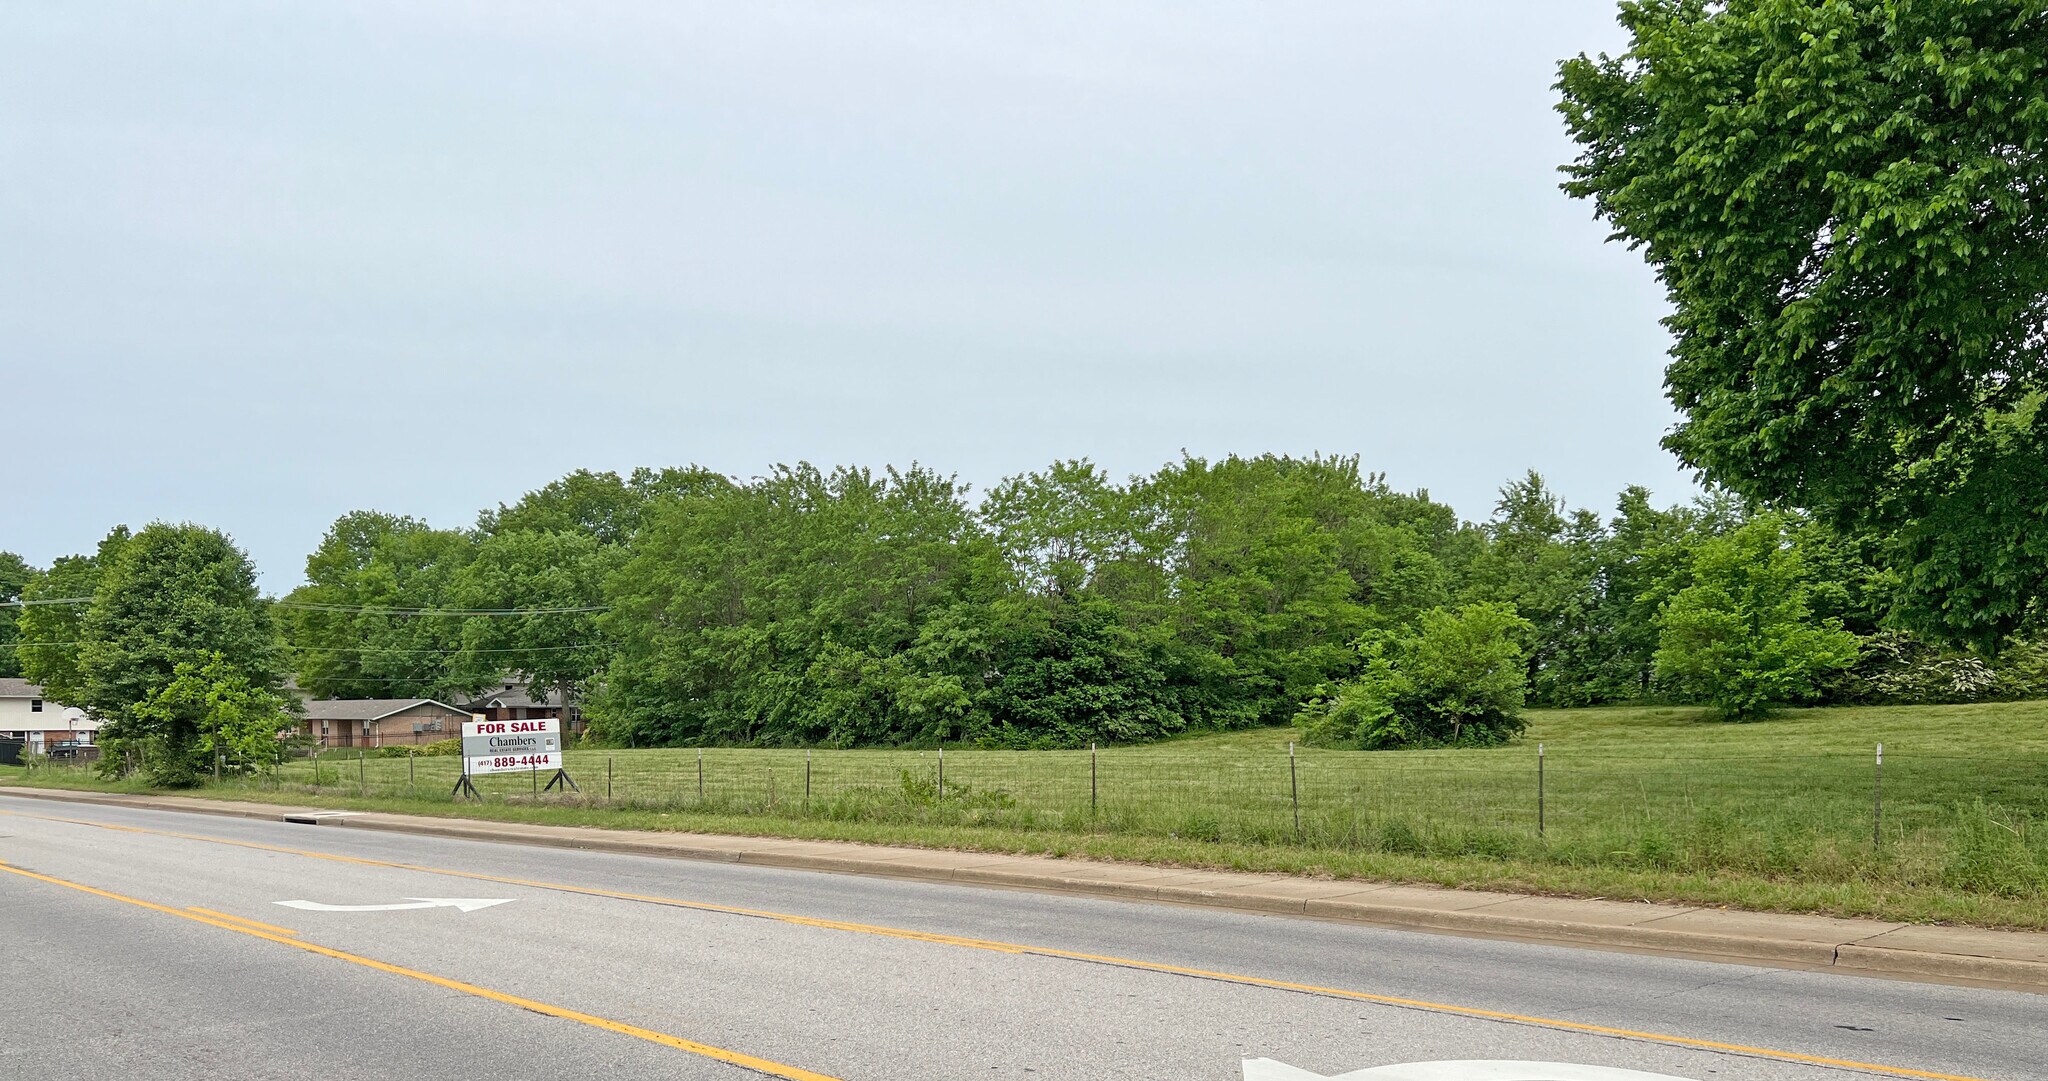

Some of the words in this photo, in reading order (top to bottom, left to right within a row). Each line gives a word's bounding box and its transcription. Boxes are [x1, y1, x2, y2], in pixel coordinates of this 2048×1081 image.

[477, 723, 505, 734] FOR
[511, 721, 546, 732] SALE
[489, 736, 537, 747] Chambers
[494, 754, 549, 768] 889-4444
